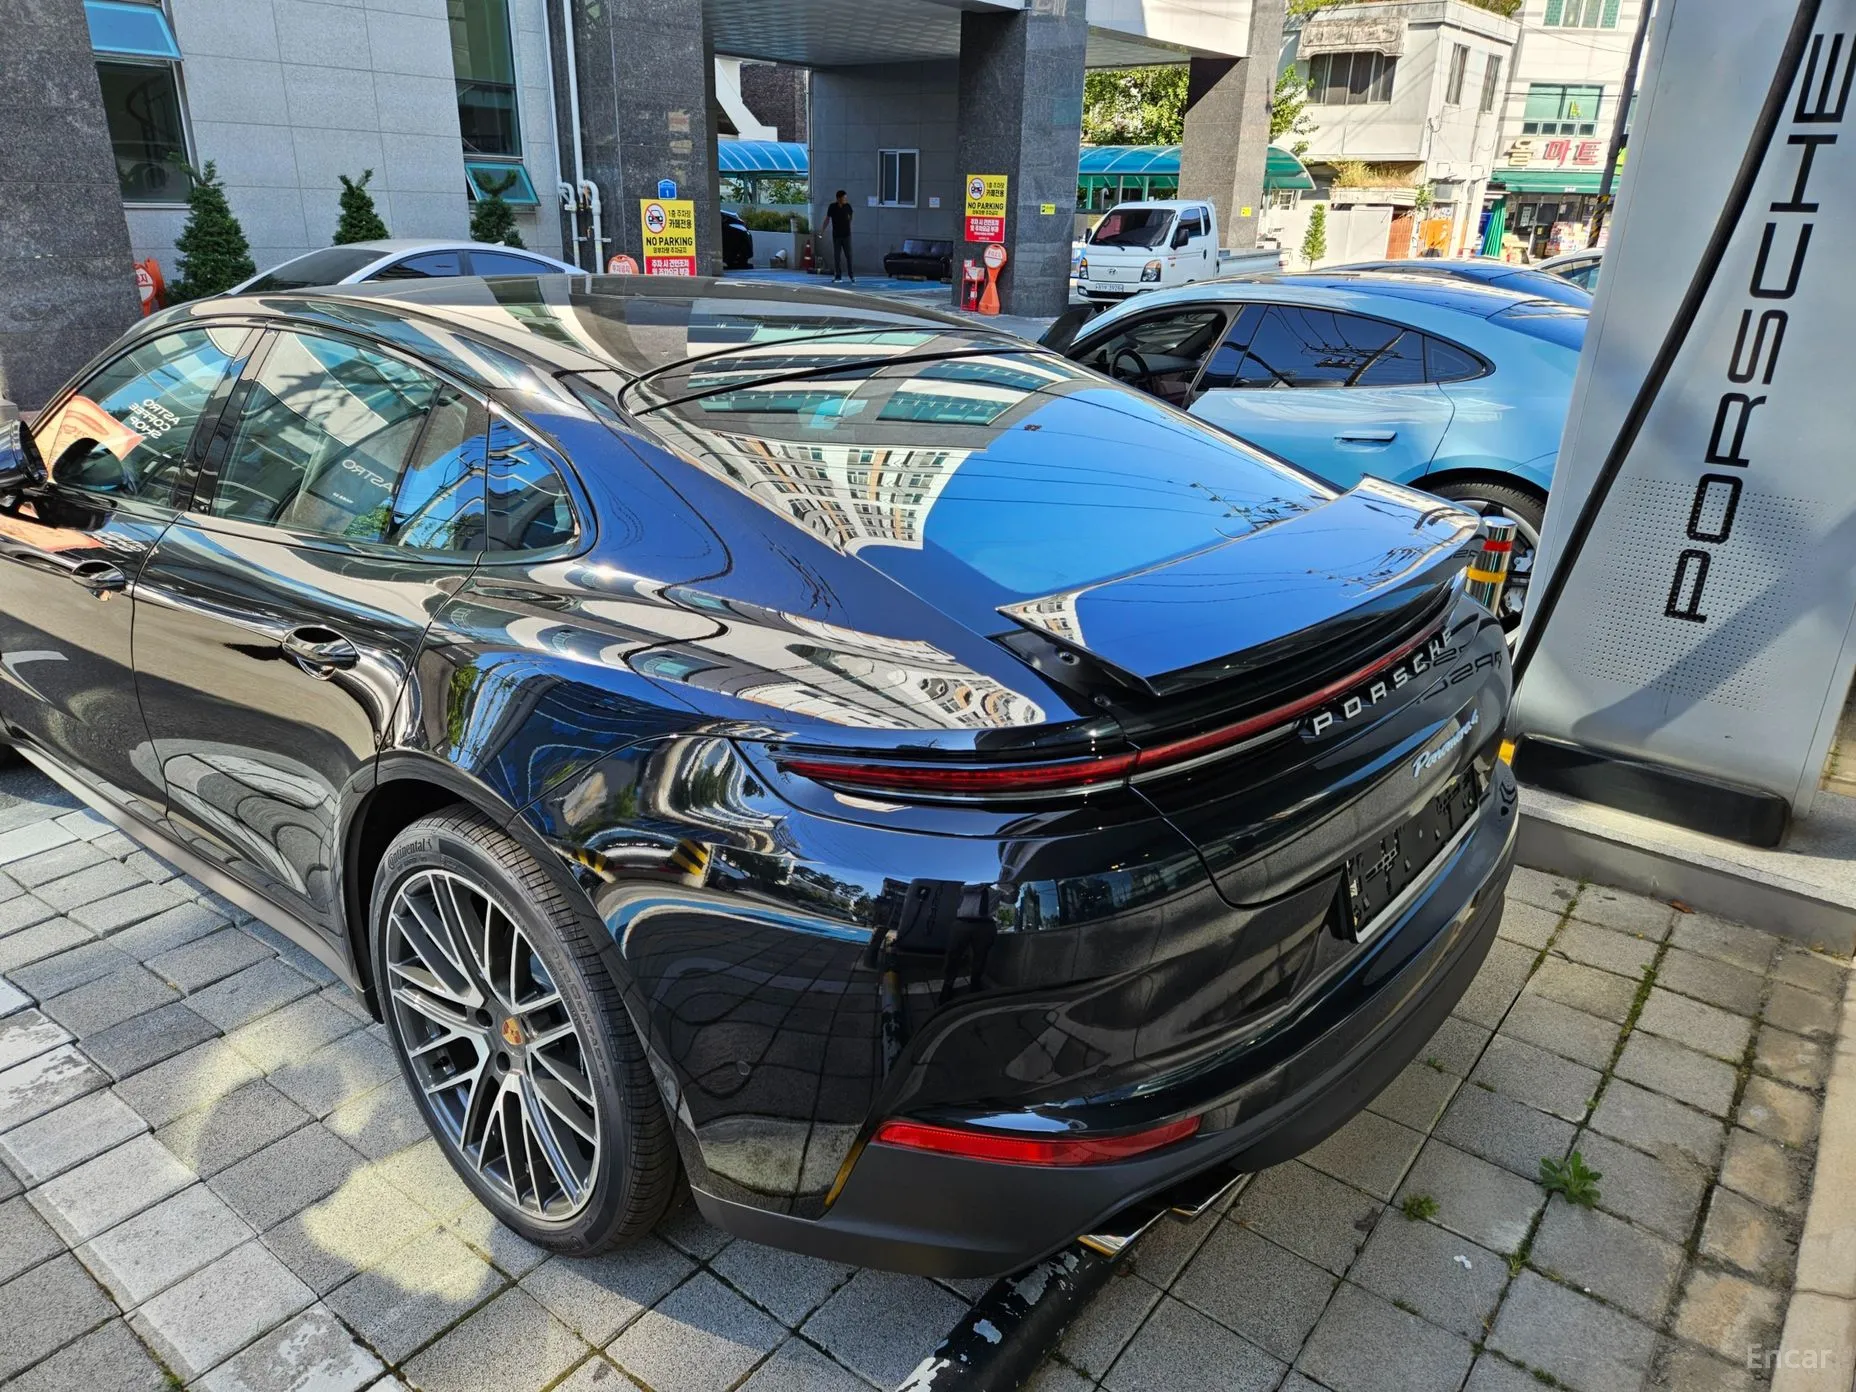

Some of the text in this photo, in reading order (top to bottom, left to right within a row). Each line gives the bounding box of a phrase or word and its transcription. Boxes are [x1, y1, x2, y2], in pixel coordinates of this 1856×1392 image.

[977, 202, 1004, 210] PARKING
[646, 236, 693, 246] NO PARKING
[1664, 33, 1856, 623] PORSCHE
[1312, 627, 1452, 736] PORSCHE
[387, 838, 425, 870] Continental
